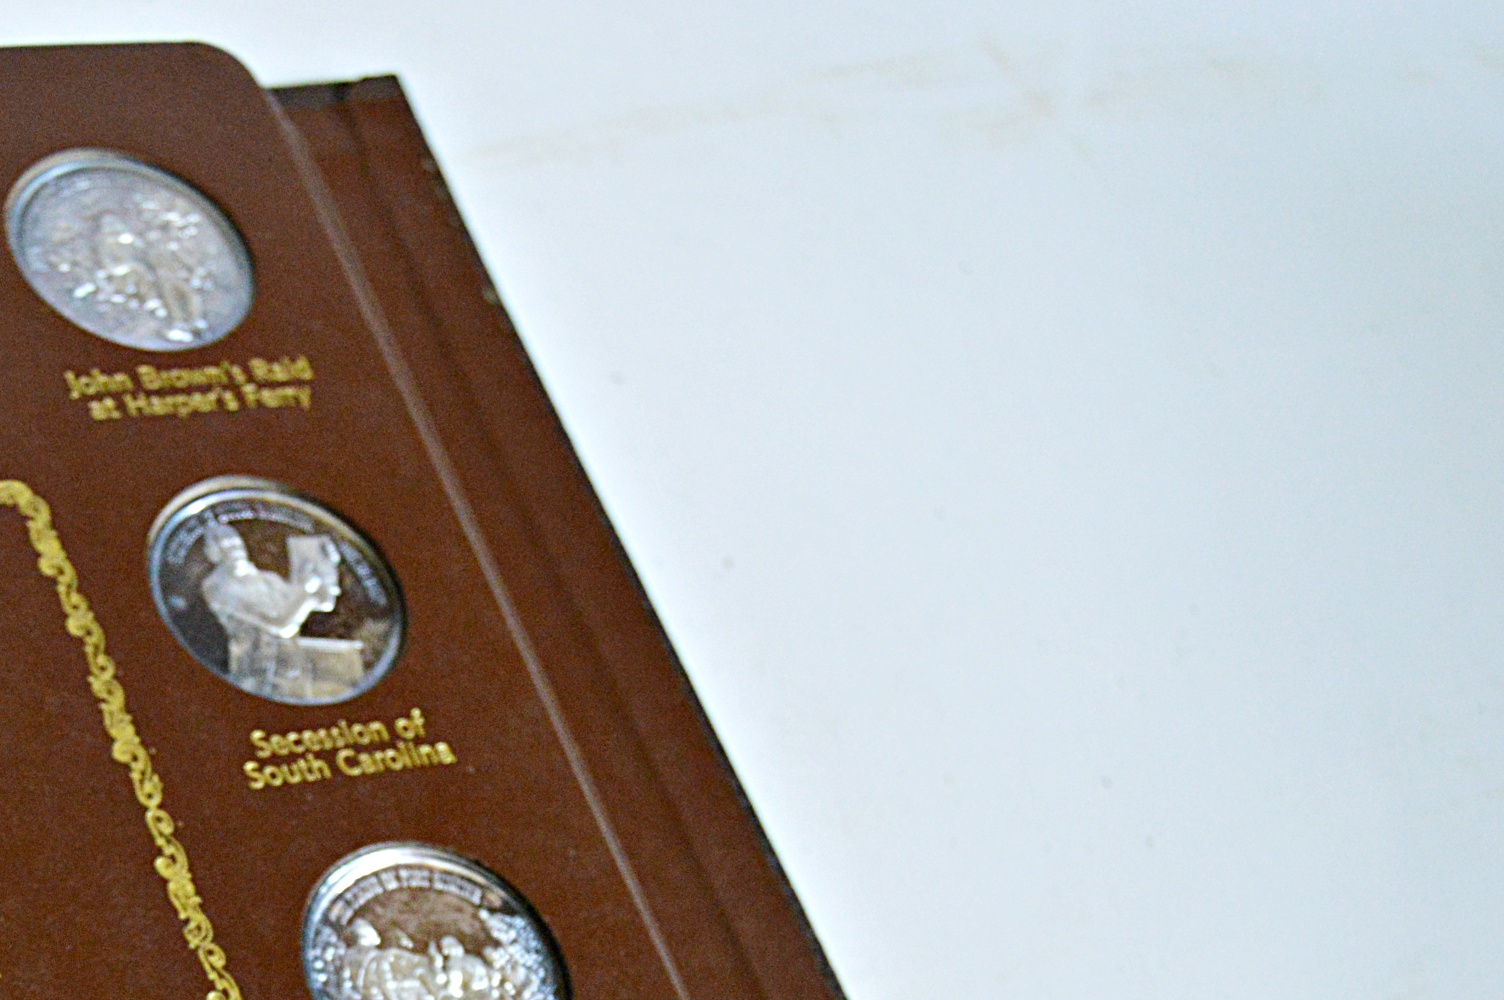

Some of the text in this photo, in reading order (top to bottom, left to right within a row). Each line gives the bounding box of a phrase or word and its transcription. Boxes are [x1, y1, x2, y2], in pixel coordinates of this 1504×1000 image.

[64, 354, 315, 400] John Brown's Raid
[87, 382, 312, 422] at Harper's Ferry
[249, 707, 426, 759] Secession of
[242, 741, 457, 790] South Carolina
